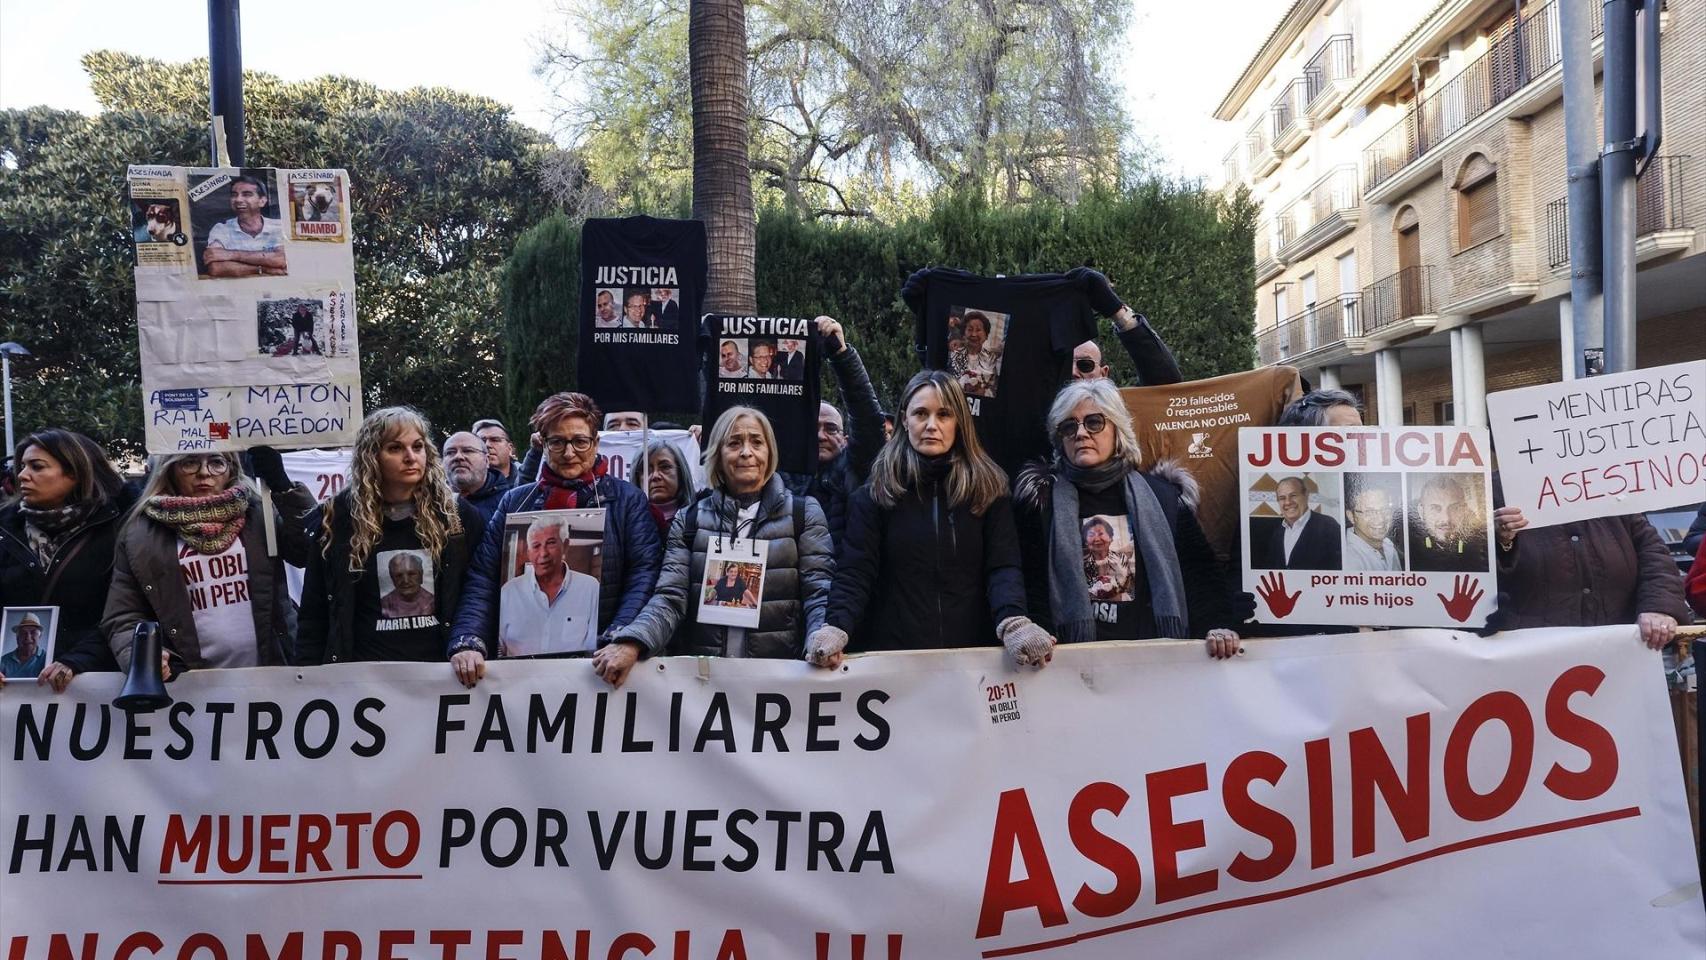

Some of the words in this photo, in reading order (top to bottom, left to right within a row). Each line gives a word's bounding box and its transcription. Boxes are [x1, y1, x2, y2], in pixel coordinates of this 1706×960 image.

[291, 172, 335, 180] ASESINADO
[190, 174, 229, 199] ASESINADO
[301, 223, 337, 234] MAMBO
[595, 266, 678, 285] JUSTICIA
[721, 317, 809, 336] JUSTICIA
[594, 333, 610, 343] POR
[612, 333, 628, 343] MIS
[628, 333, 679, 345] FAMILIARES
[718, 382, 736, 393] POR
[738, 382, 755, 394] MIS
[756, 383, 803, 396] FAMILIARES
[1548, 373, 1692, 421] MENTIRAS
[1169, 397, 1188, 407] 229
[1189, 392, 1235, 406] fallecidos
[154, 408, 215, 425] RATA
[278, 404, 303, 416] AL
[1166, 408, 1173, 417] 0
[1175, 402, 1239, 417] responsables
[236, 412, 344, 438] PAREDÓN
[1155, 419, 1200, 431] VALENCIA
[1202, 418, 1217, 428] NO
[1218, 412, 1251, 426] OLVIDA
[1553, 410, 1706, 459] JUSTICIA
[1248, 432, 1484, 467] JUSTICIA
[1538, 452, 1706, 510] ASESINO
[181, 560, 204, 586] NI
[1311, 574, 1339, 588] por
[1344, 573, 1364, 586] mi
[1369, 573, 1427, 587] marido
[189, 587, 207, 611] NI
[210, 580, 252, 607] PER
[1325, 595, 1335, 607] y
[1340, 593, 1369, 606] mis
[1373, 593, 1414, 608] hijos
[412, 615, 440, 629] LUISA
[986, 682, 1017, 702] 20:11
[989, 704, 997, 714] NI
[998, 700, 1018, 712] OBLIT
[13, 697, 386, 761] NUESTROS
[434, 689, 891, 754] FAMILIARES
[991, 715, 999, 724] NI
[975, 664, 1619, 939] ASESINOS
[8, 814, 146, 874] HAN
[159, 809, 421, 874] MUERTO
[439, 807, 570, 868] POR
[586, 808, 896, 874] VUESTRA
